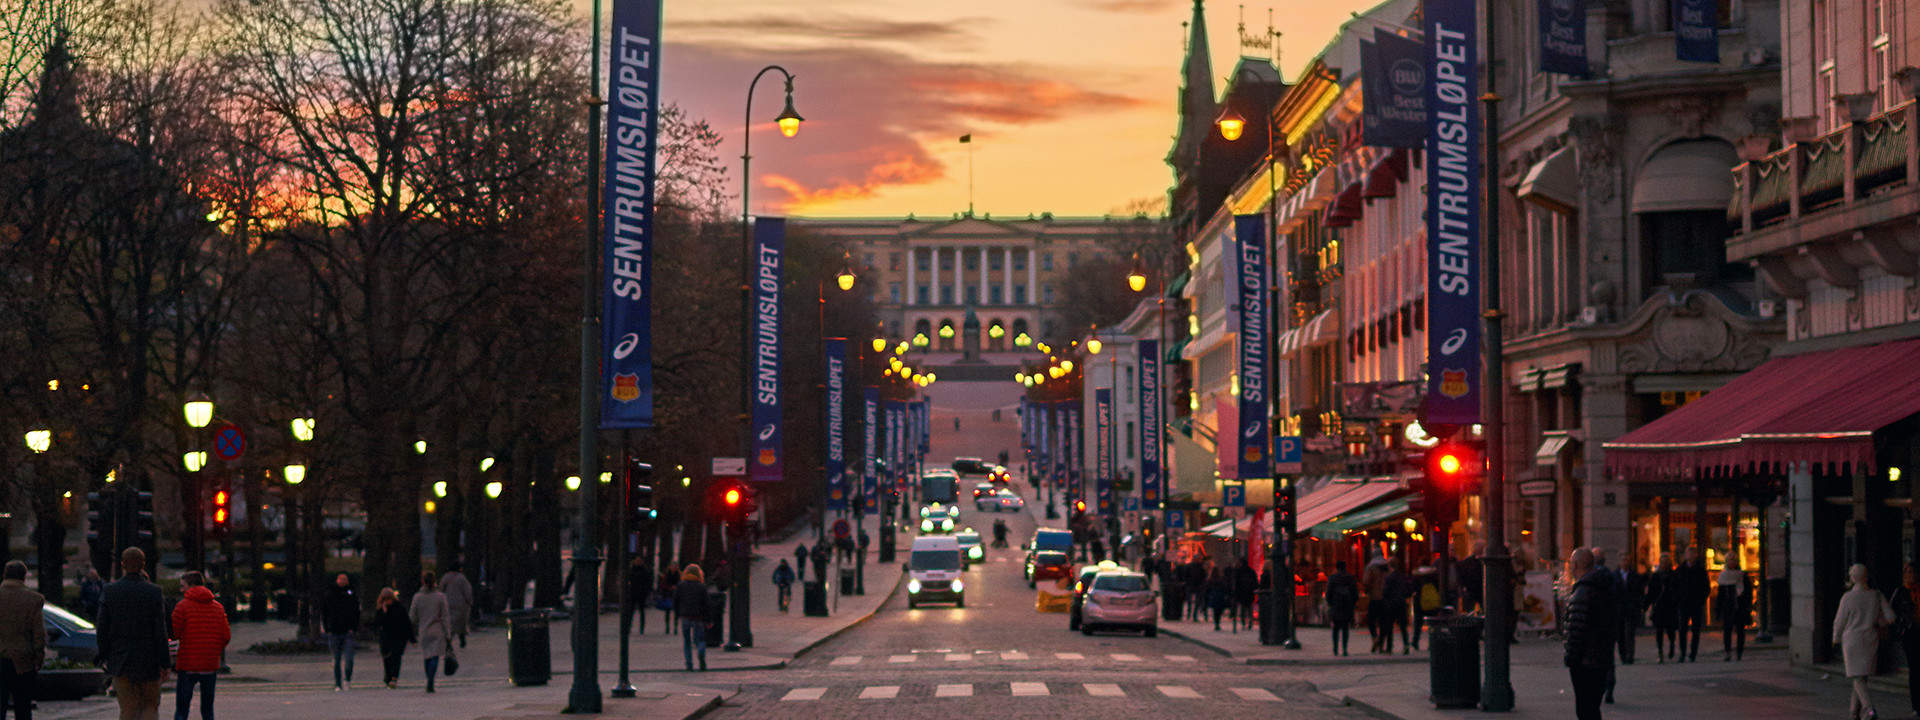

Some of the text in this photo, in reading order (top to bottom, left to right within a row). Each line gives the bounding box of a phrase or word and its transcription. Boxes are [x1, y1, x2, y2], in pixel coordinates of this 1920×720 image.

[613, 27, 651, 301] SENTRUMSLØPET
[1435, 22, 1469, 296] SENTRUMSLØPET
[758, 243, 780, 406] SENTRUMSLØPET
[1242, 240, 1262, 403] SENTRUMSLØPET
[1171, 512, 1181, 527] P
[1228, 487, 1240, 504] P
[1281, 439, 1295, 460] P
